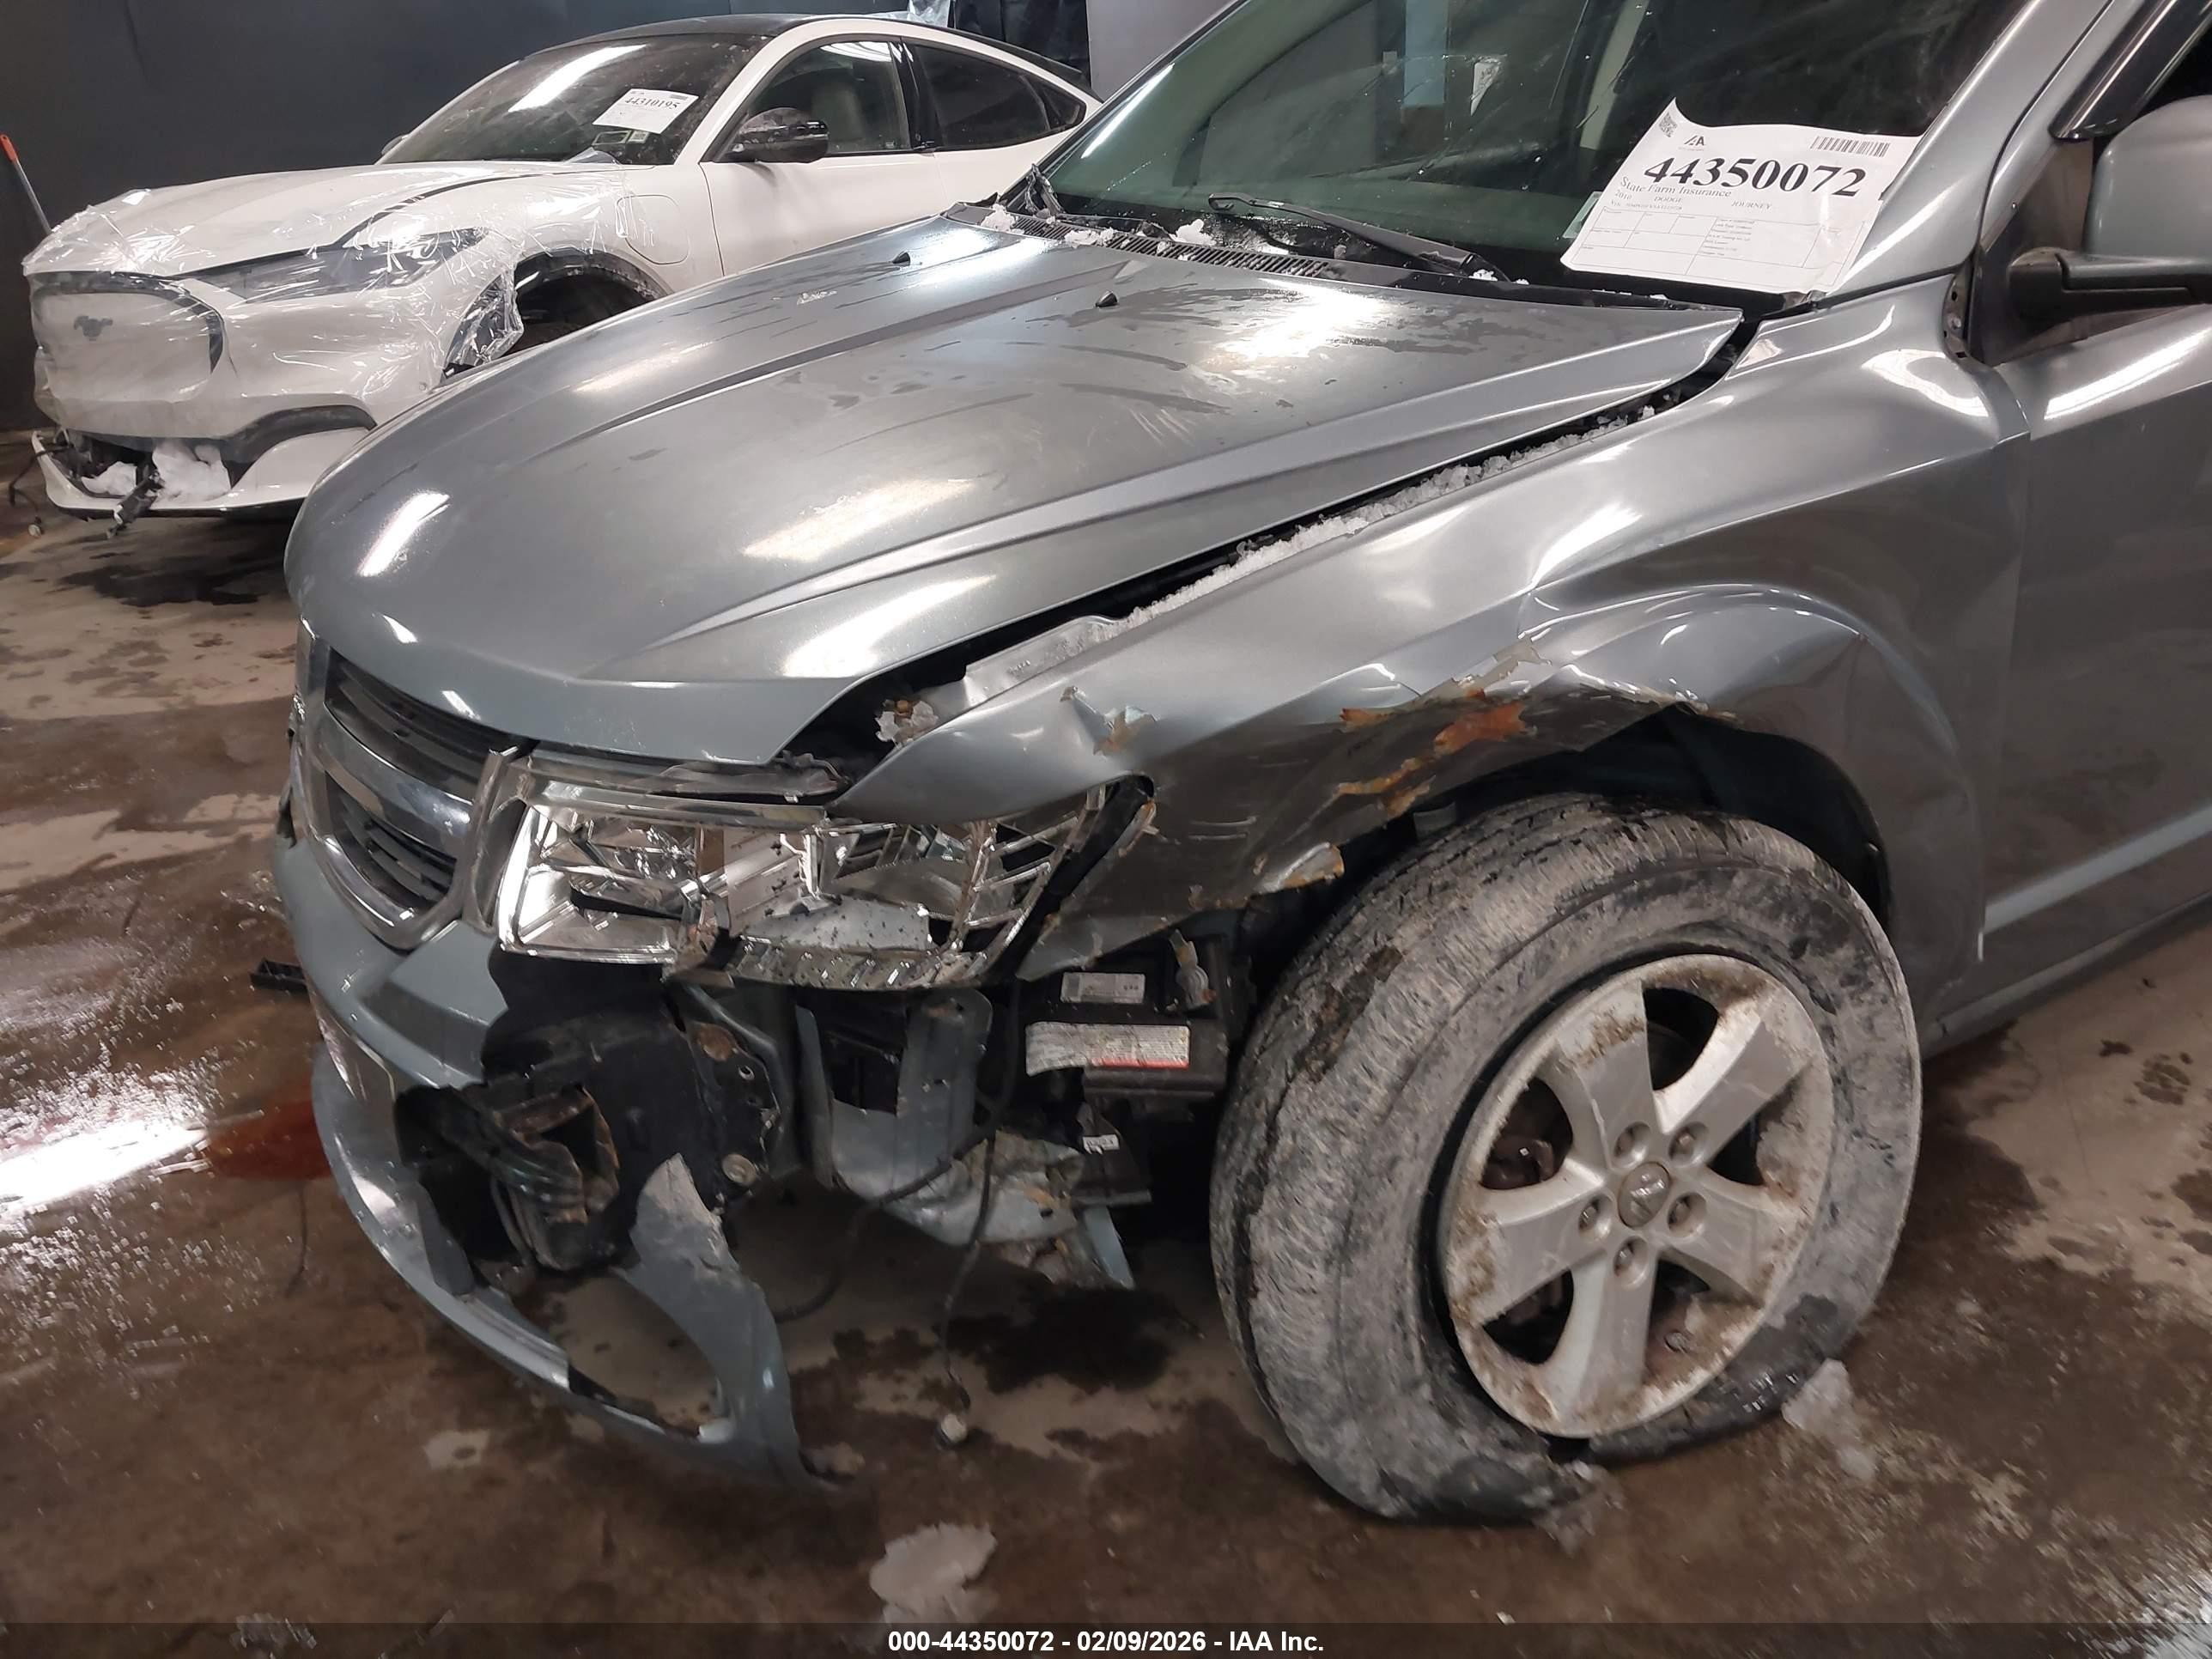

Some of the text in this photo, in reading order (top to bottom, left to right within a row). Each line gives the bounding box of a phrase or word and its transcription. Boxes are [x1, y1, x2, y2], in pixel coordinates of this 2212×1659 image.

[624, 96, 681, 110] 44310195
[1644, 156, 1866, 198] 44350072
[1620, 176, 1732, 198] State Farm Insurance
[1731, 200, 1772, 210] JOURNEY
